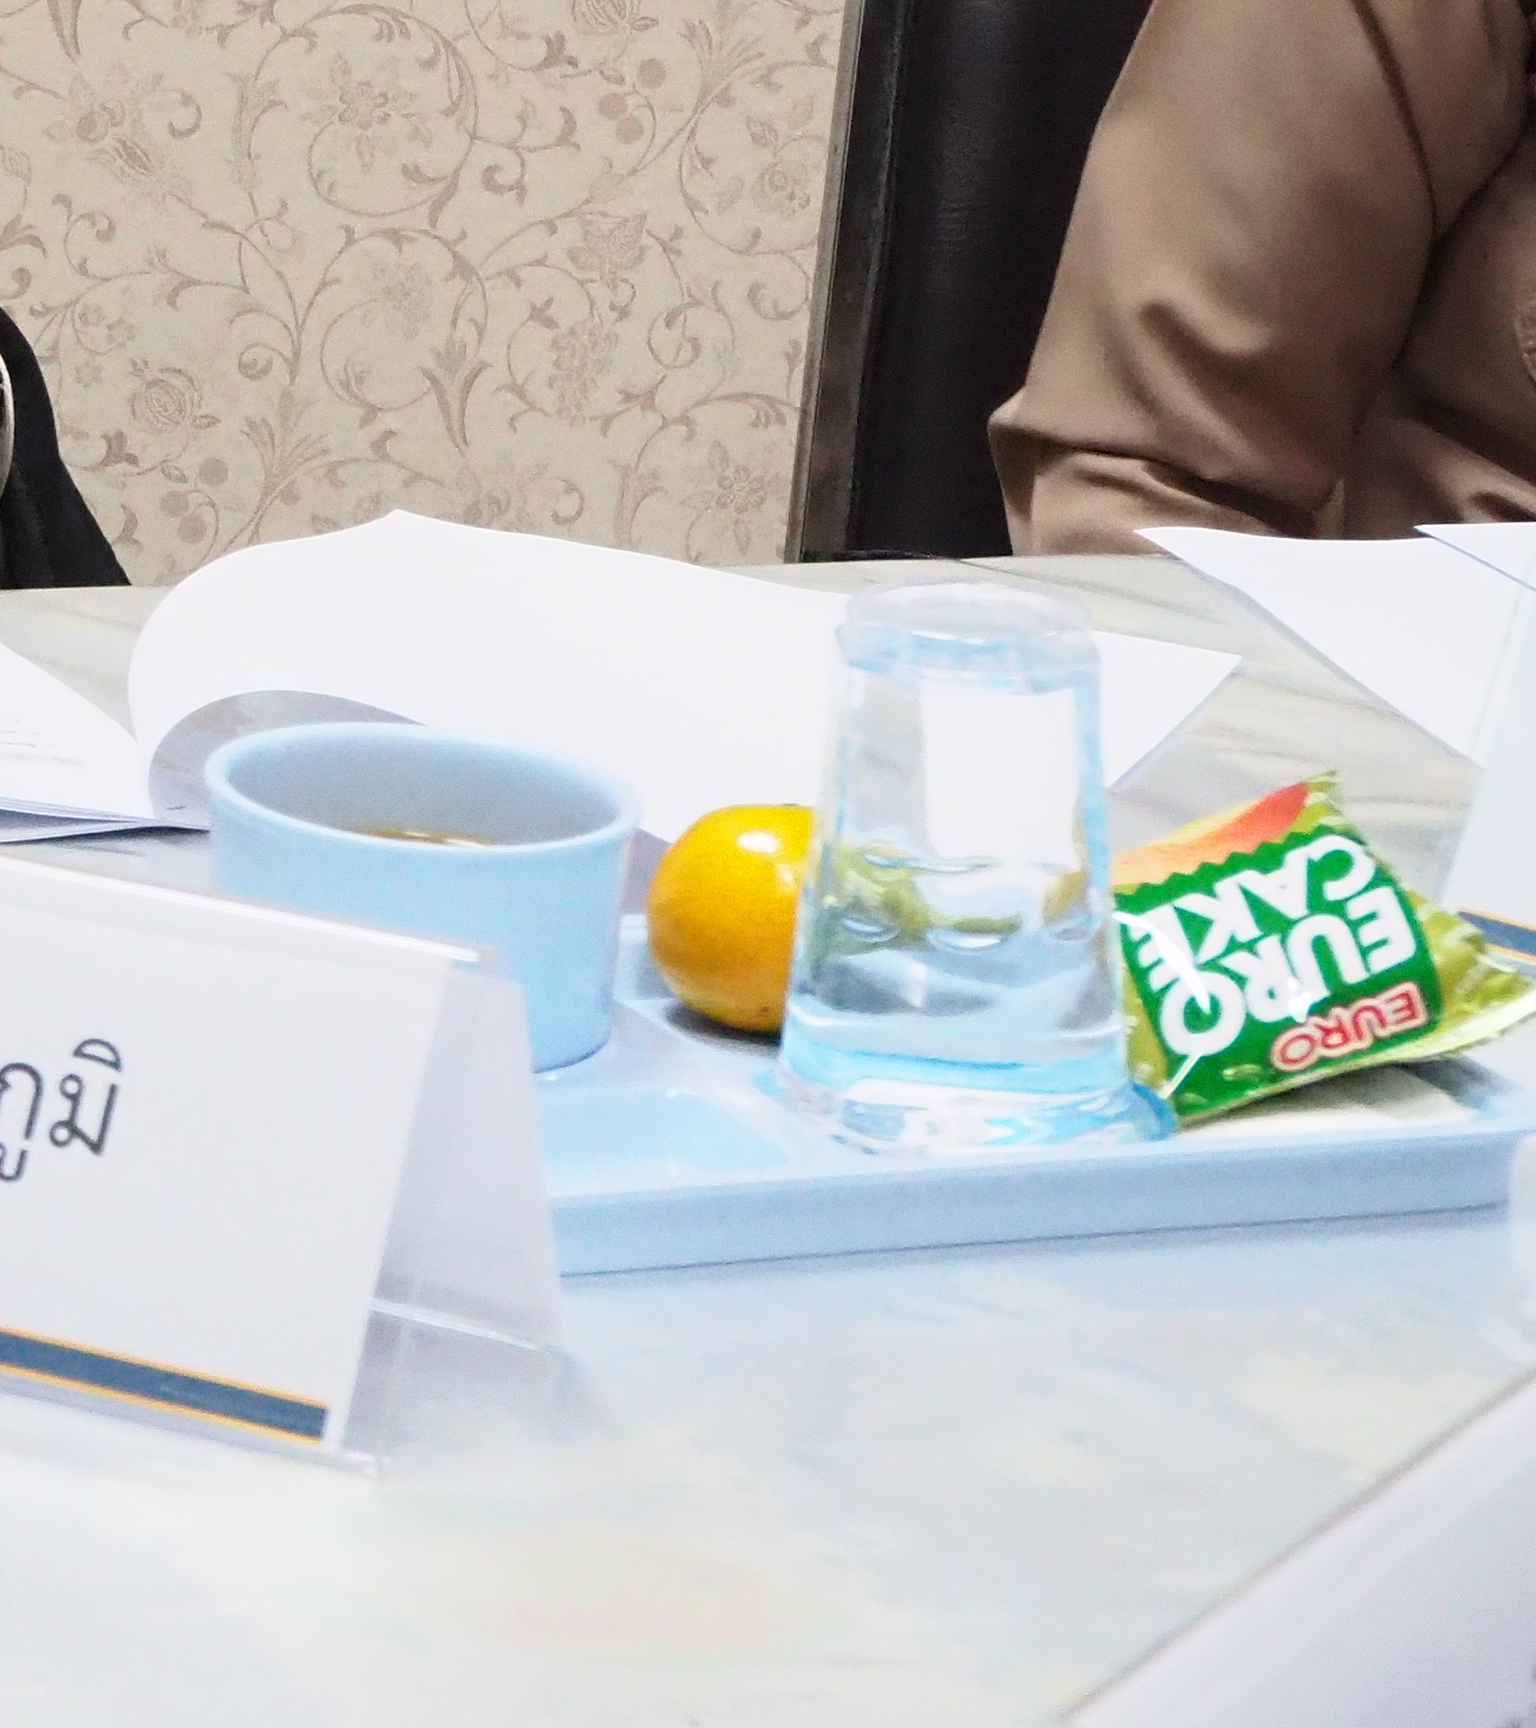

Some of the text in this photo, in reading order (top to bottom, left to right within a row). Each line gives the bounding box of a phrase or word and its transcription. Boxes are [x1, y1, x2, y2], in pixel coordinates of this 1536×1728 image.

[1124, 834, 1376, 992] CAKE
[1160, 886, 1416, 1057] EURO
[1273, 985, 1424, 1069] EURO
